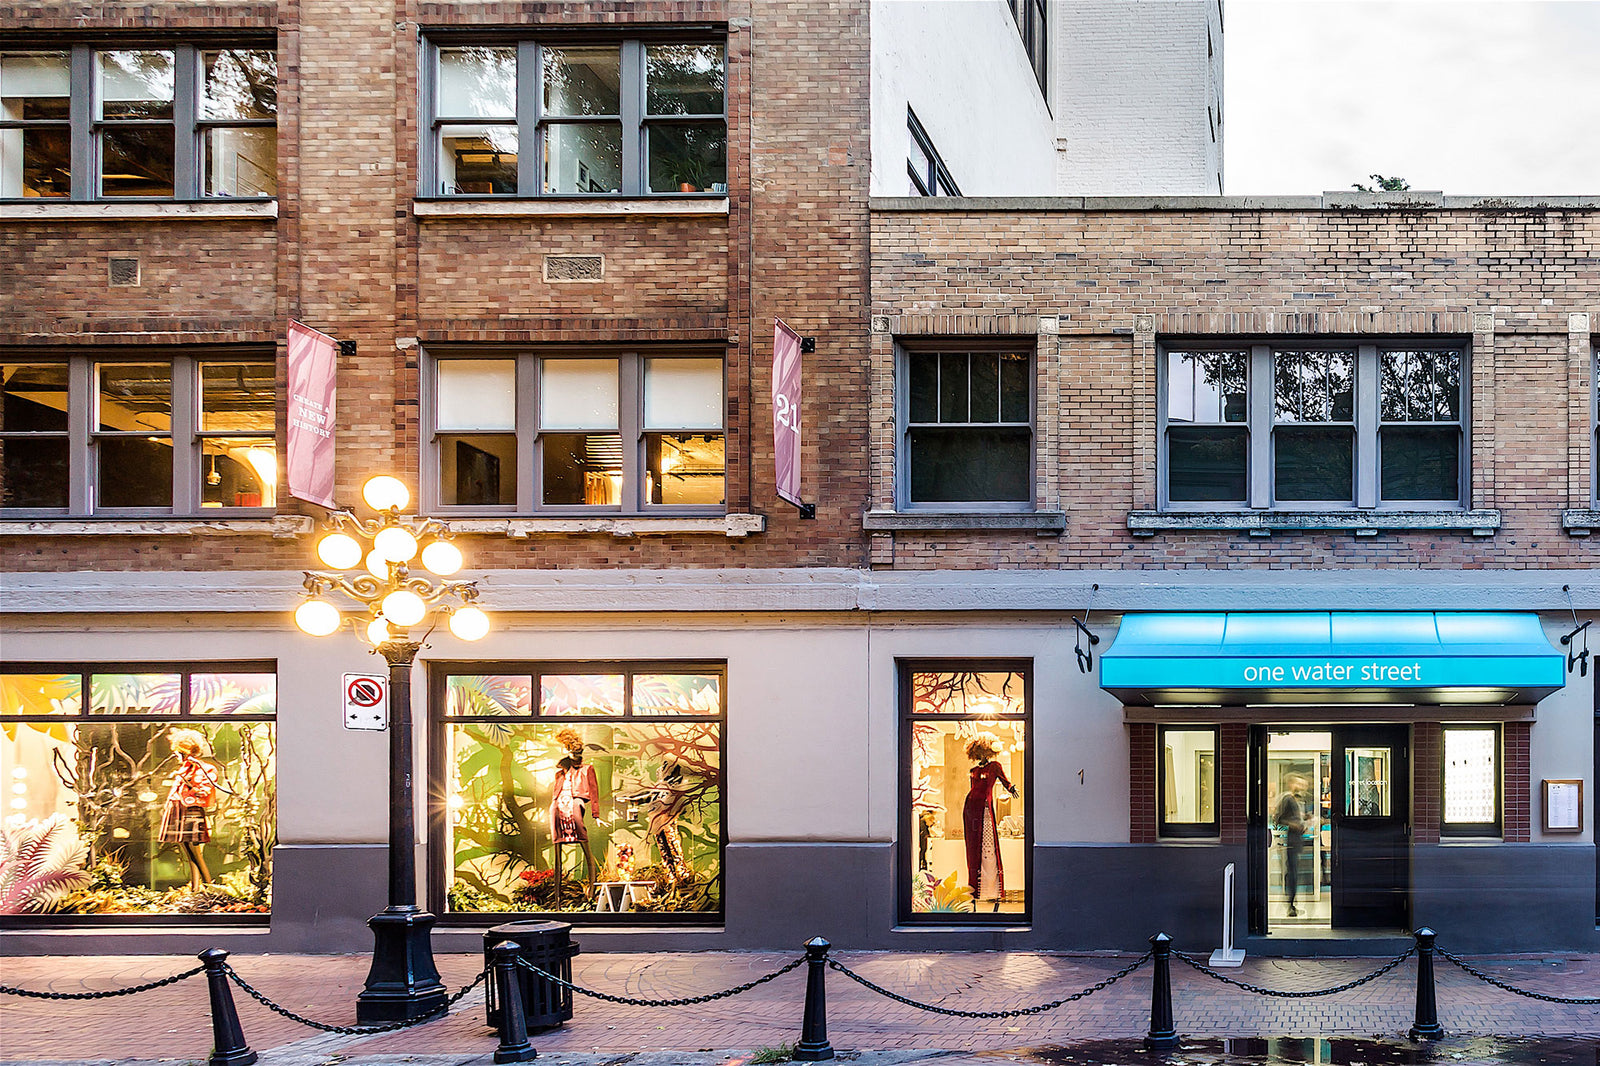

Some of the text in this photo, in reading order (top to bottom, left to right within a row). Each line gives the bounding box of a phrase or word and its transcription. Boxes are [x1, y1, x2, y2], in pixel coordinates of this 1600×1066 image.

[293, 394, 330, 414] CREATE A
[776, 394, 799, 434] 21
[298, 406, 326, 425] NEW
[293, 419, 331, 439] HISTORY
[1243, 662, 1421, 682] one water street
[1077, 768, 1085, 786] 1
